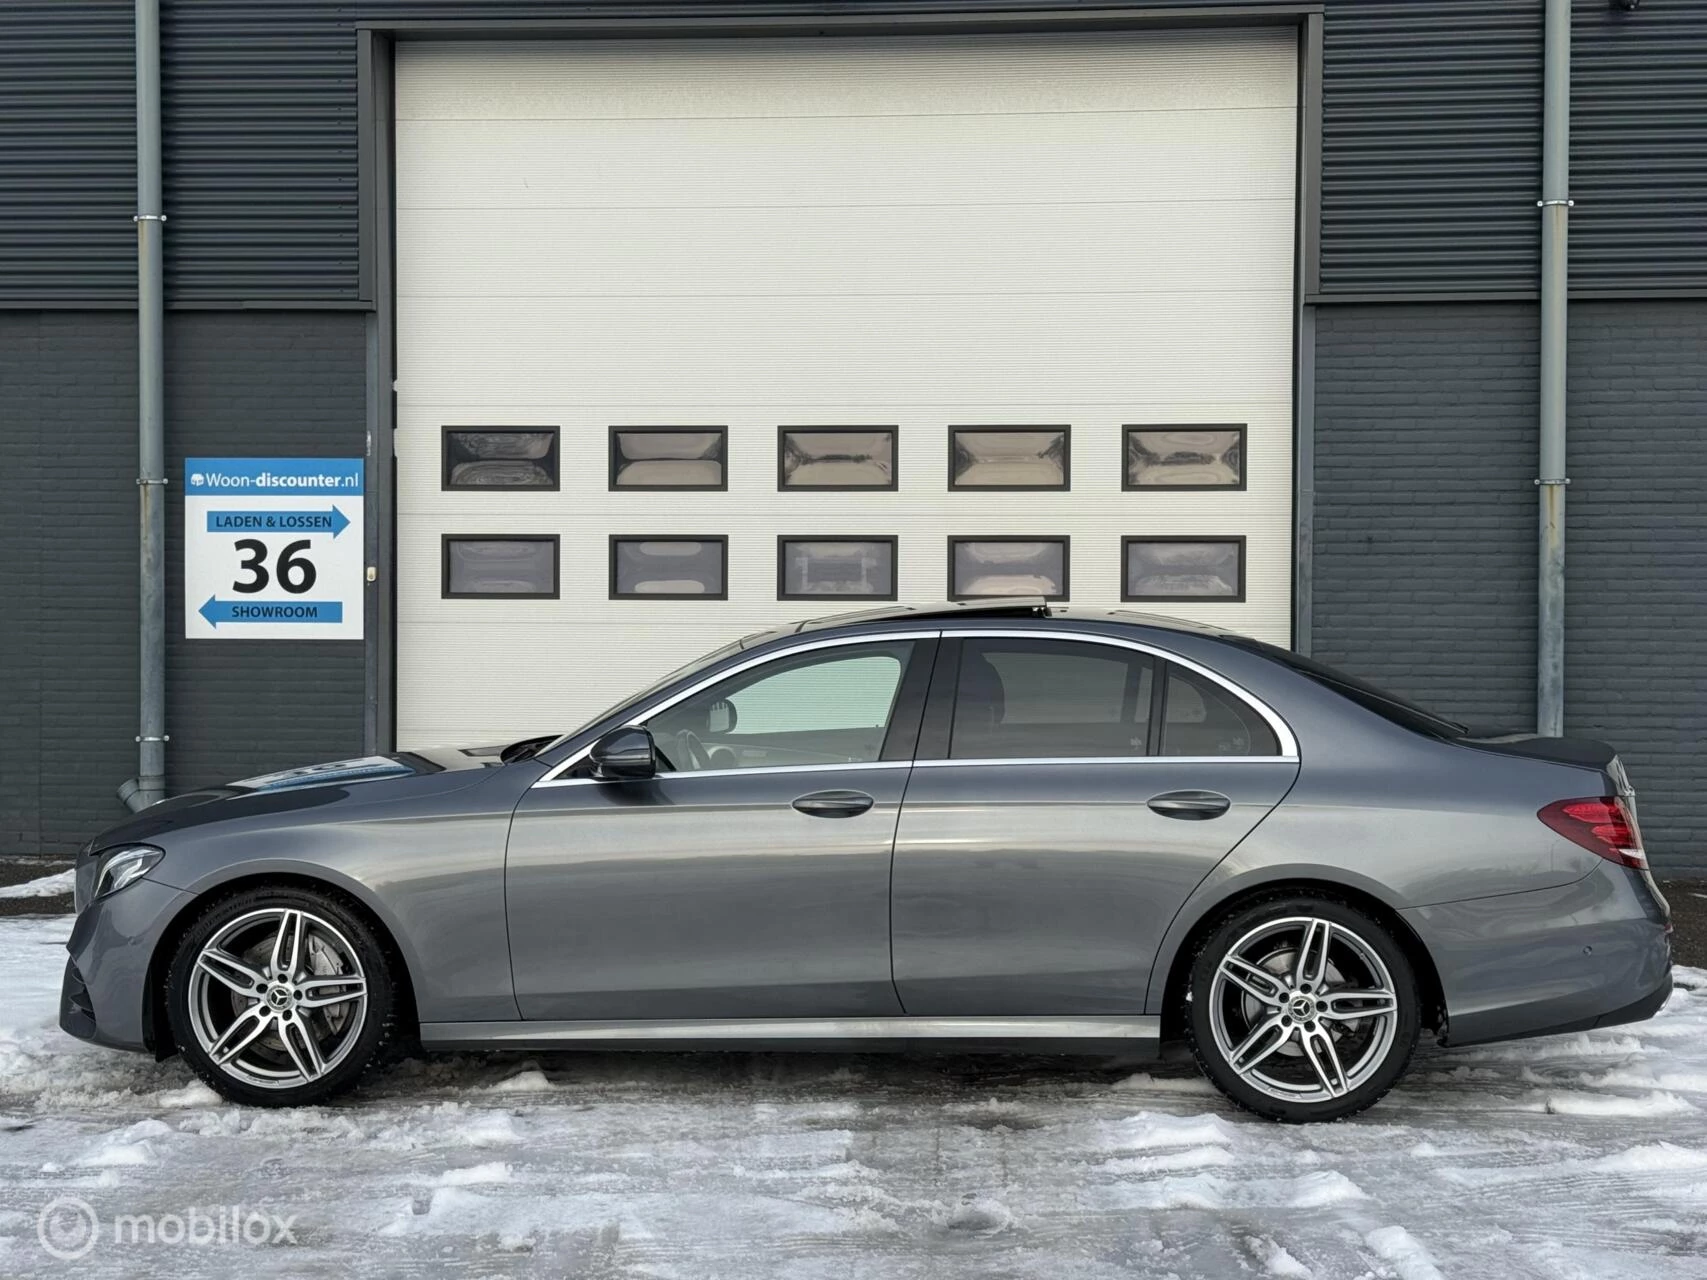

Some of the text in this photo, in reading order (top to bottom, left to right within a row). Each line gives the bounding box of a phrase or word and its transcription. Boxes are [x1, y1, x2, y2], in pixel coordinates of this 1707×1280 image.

[205, 472, 359, 488] Woon-discounter.nl
[215, 515, 332, 528] LADEN & LOSSEN
[232, 538, 317, 594] 36
[231, 605, 318, 618] SHOWROOM
